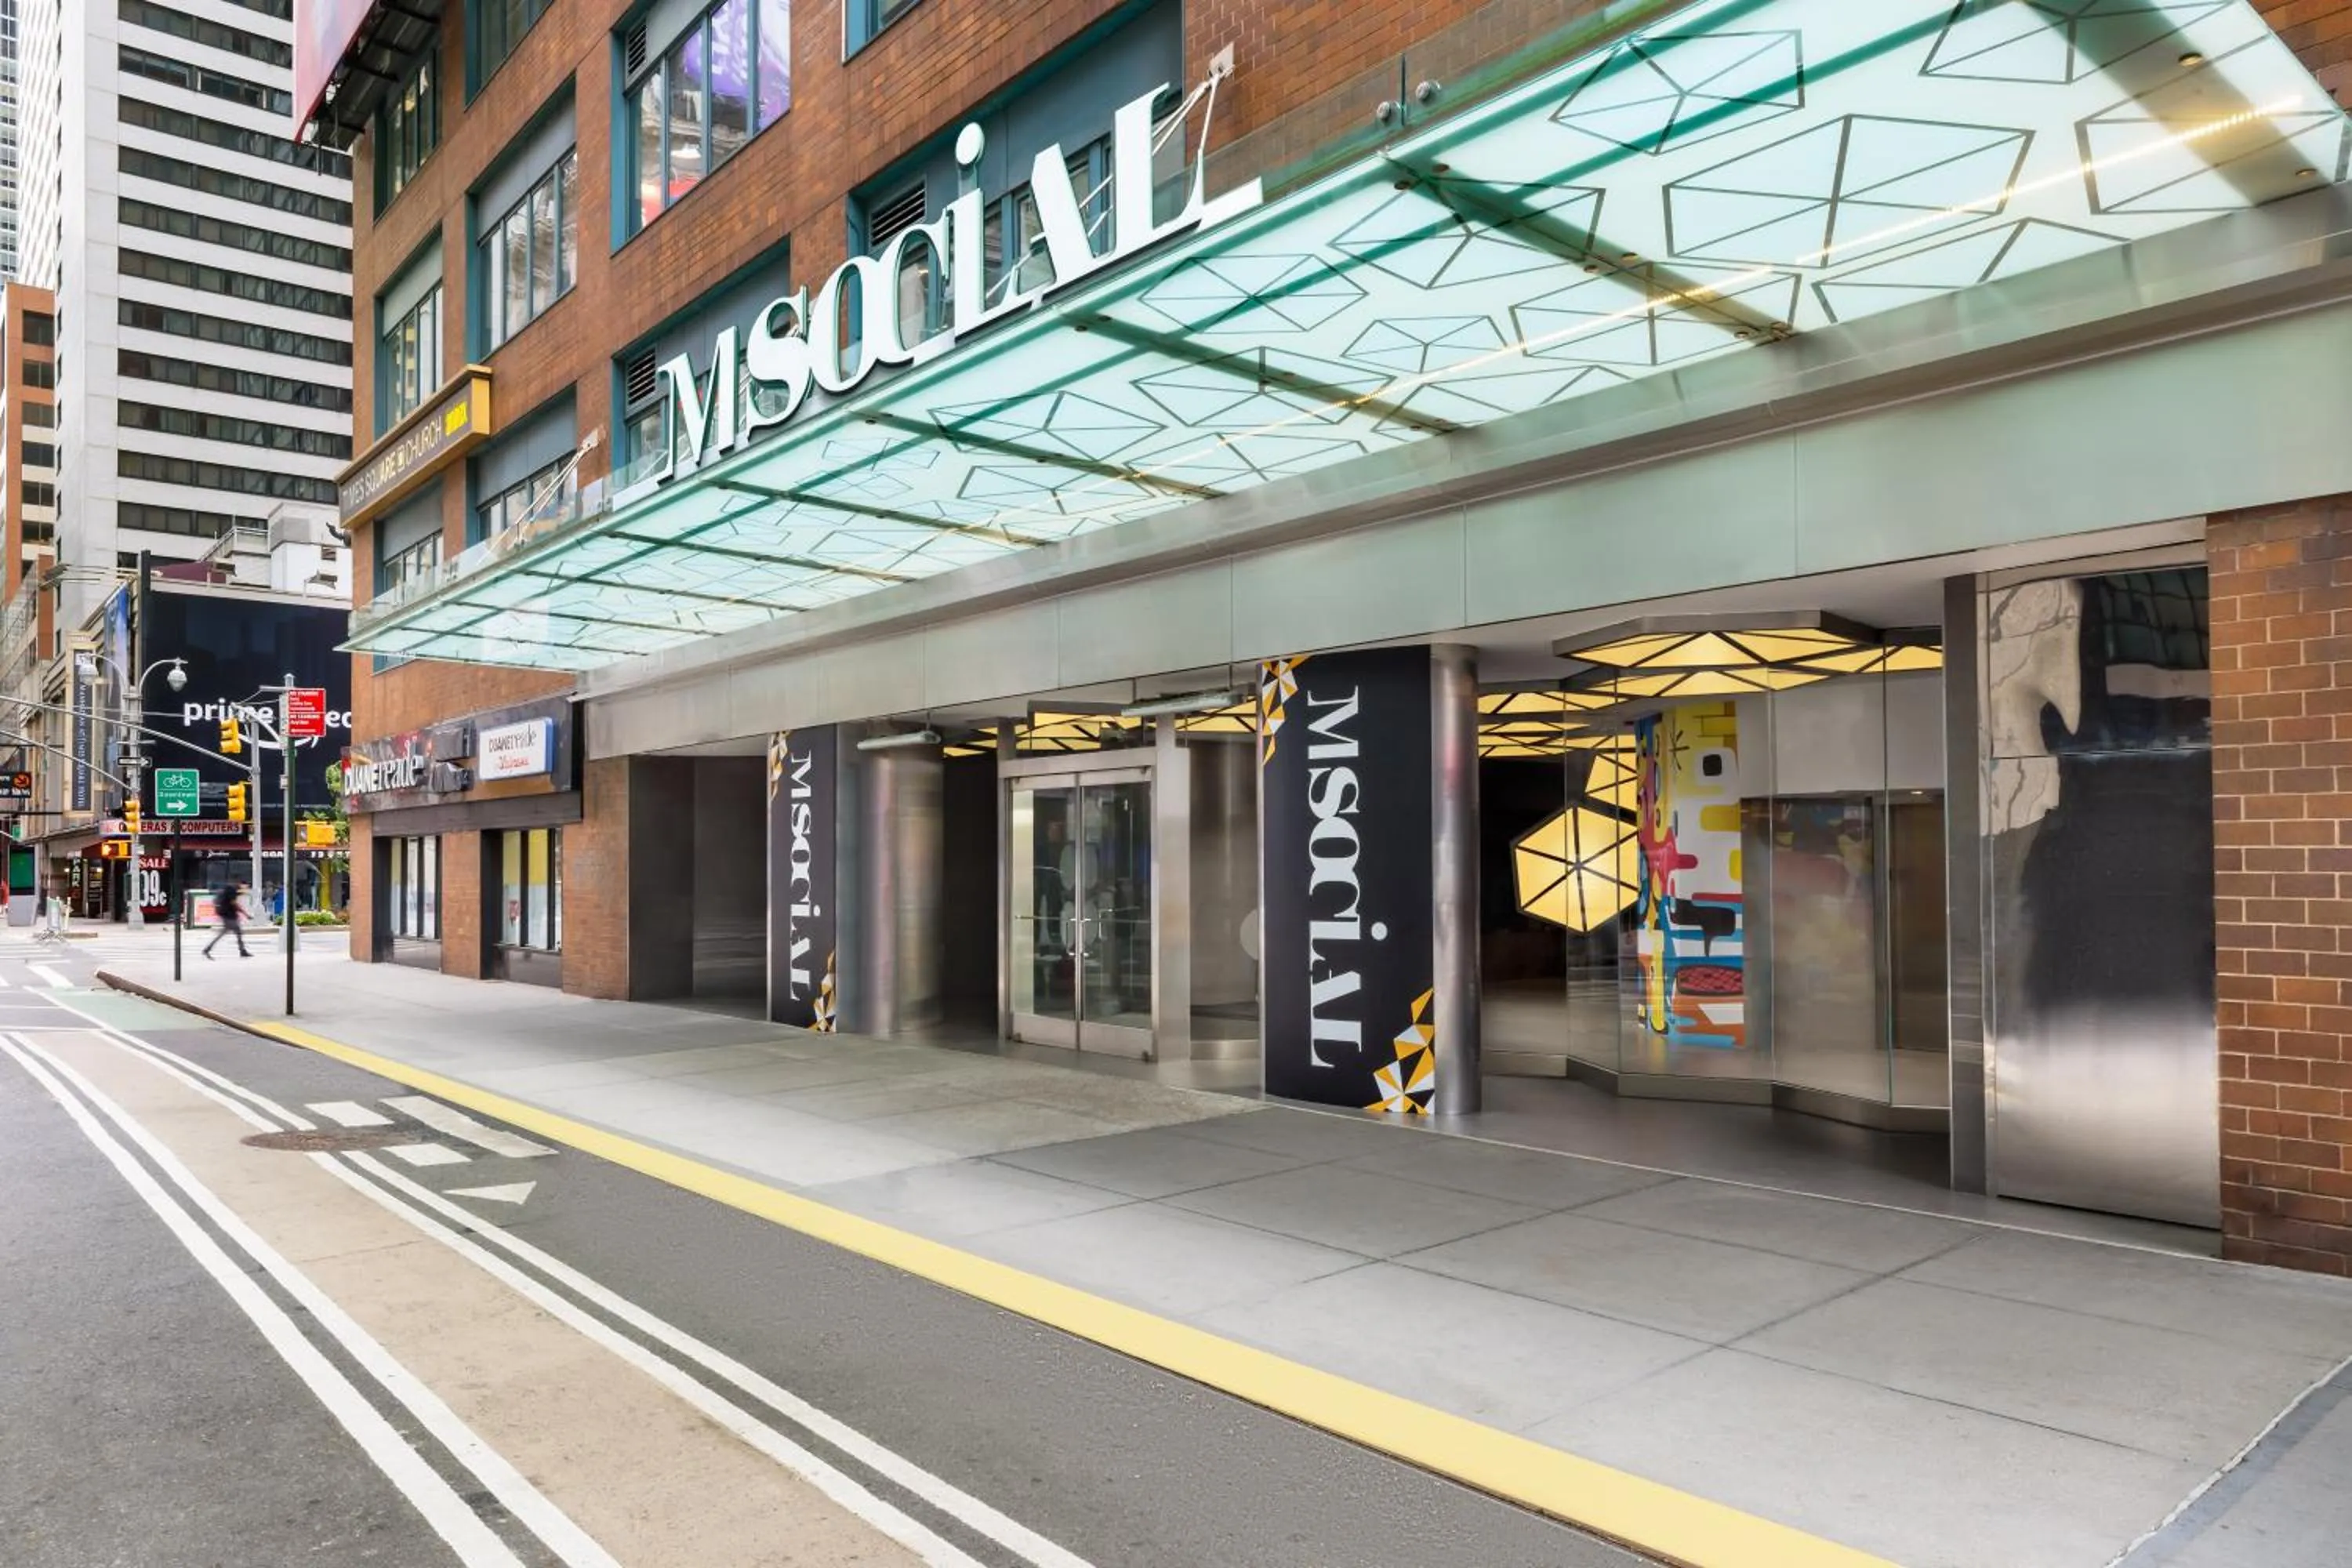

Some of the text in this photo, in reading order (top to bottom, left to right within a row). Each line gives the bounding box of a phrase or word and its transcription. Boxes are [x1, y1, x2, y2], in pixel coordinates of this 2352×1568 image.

[406, 415, 442, 466] CHURCH
[183, 697, 274, 727] prime
[180, 821, 240, 833] COMPUTERS
[139, 857, 169, 869] SALE
